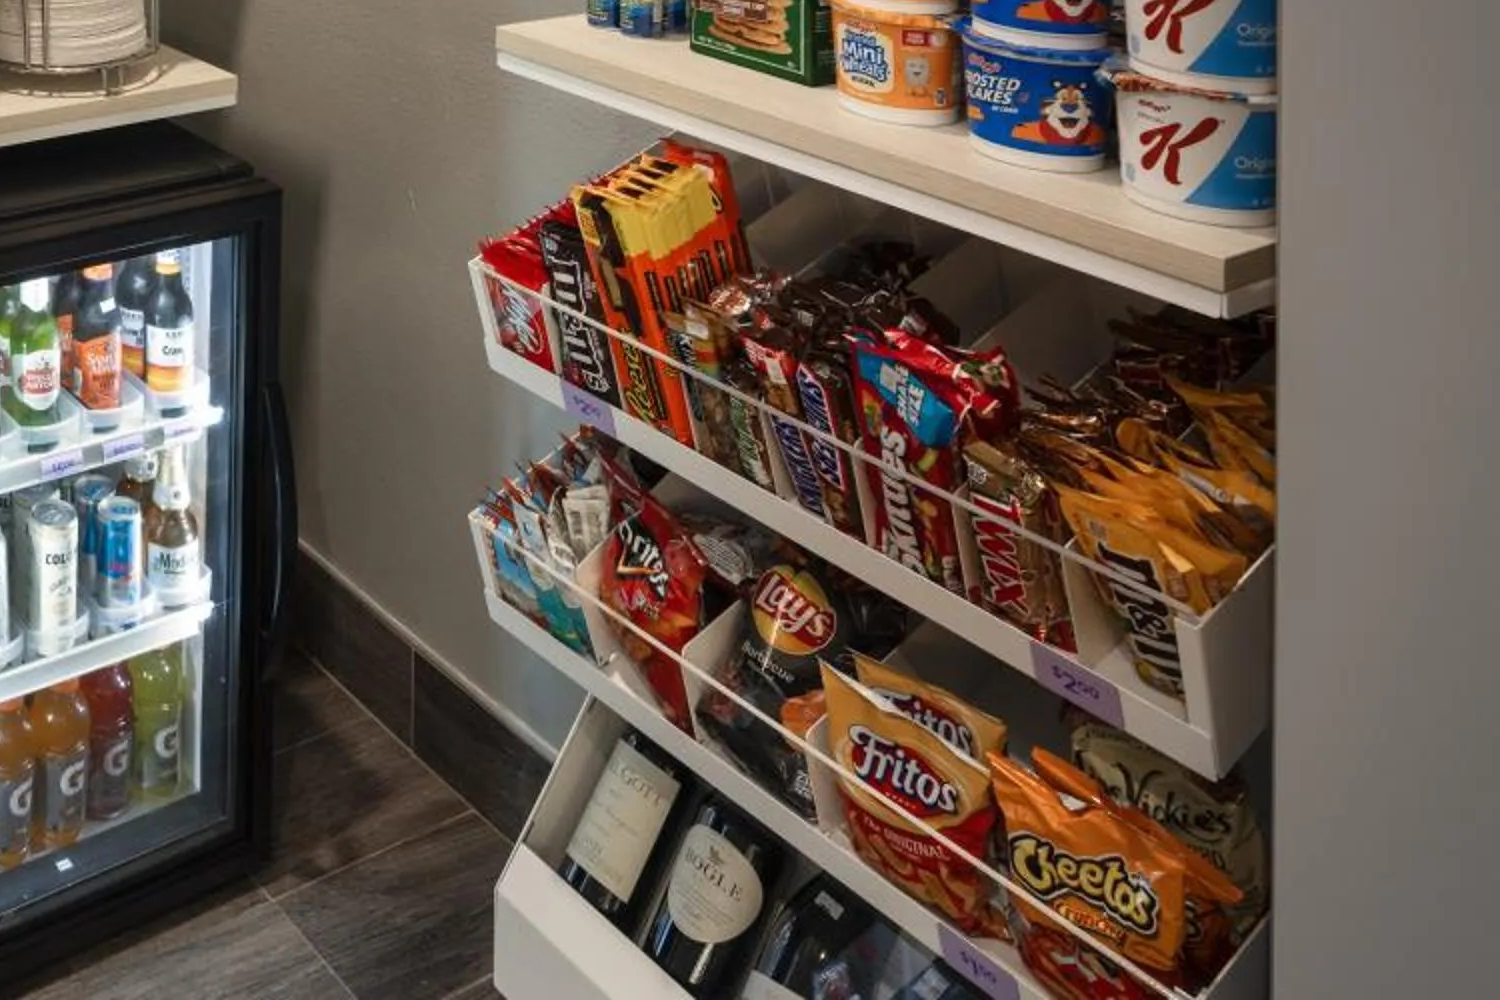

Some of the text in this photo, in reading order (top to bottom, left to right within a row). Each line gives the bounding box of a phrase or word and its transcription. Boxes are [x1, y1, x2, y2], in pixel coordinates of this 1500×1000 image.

[1237, 22, 1277, 39] Orig
[844, 41, 884, 65] Mini
[966, 70, 1021, 91] ROSTED
[1140, 117, 1220, 185] K
[1234, 157, 1277, 172] Orig
[104, 738, 129, 776] G
[850, 725, 958, 813] Fritos
[60, 760, 85, 796] G
[9, 778, 33, 816] G
[883, 827, 950, 861] ORIGINAL
[1011, 834, 1156, 930] Cheetos
